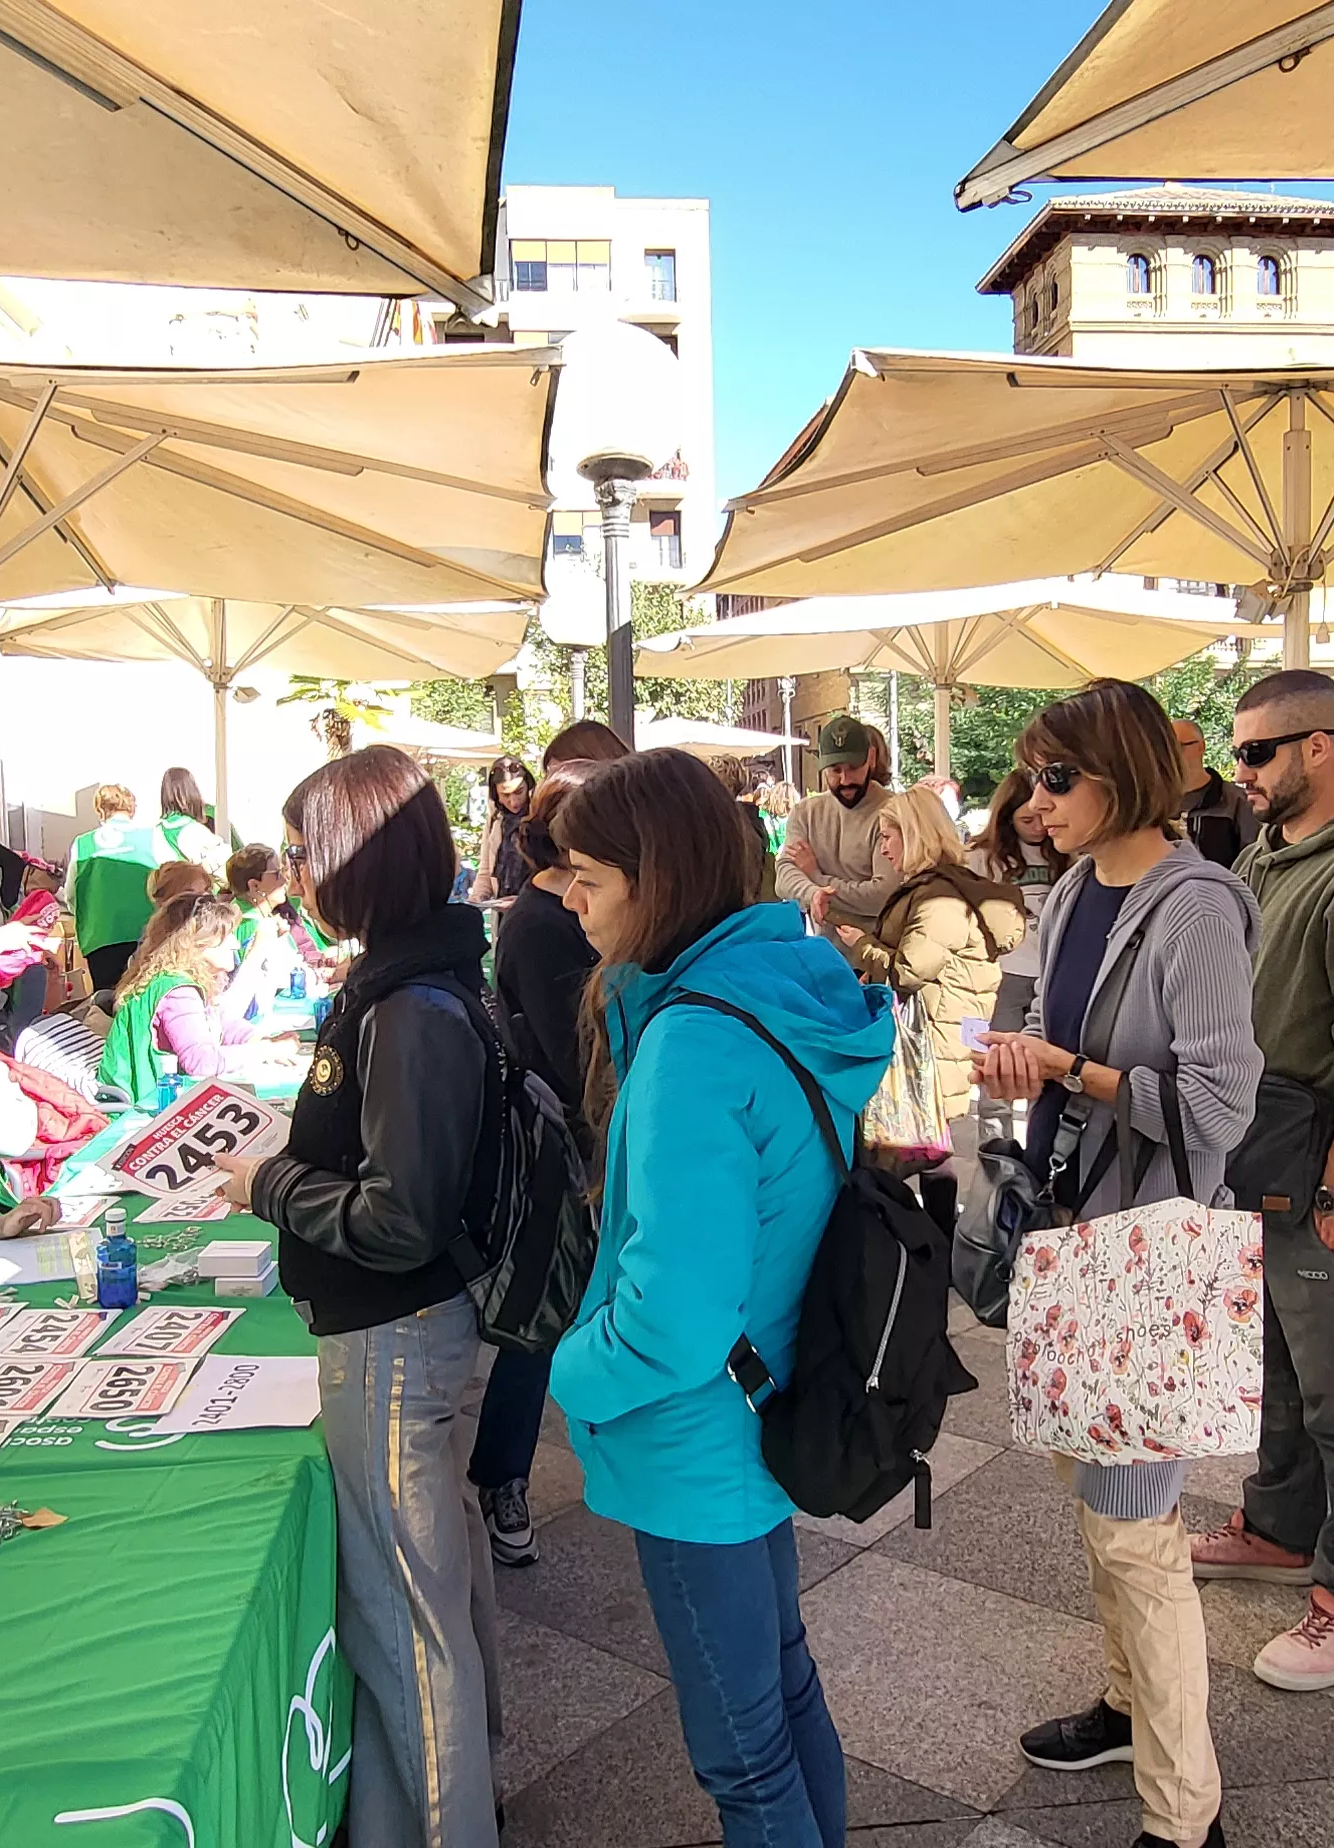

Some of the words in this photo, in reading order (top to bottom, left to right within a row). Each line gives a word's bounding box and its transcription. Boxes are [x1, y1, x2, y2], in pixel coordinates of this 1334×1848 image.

[128, 1137, 175, 1171] CONTRA
[173, 1122, 187, 1139] EL
[184, 1094, 226, 1128] CÁNCER
[145, 1103, 260, 1190] 2453
[152, 1114, 185, 1140] HUESCA
[9, 1312, 80, 1354] 2454
[135, 1312, 204, 1351] 2407
[1116, 1323, 1171, 1344] shoes
[89, 1365, 156, 1412] 2650
[191, 1363, 260, 1427] 2401-2800
